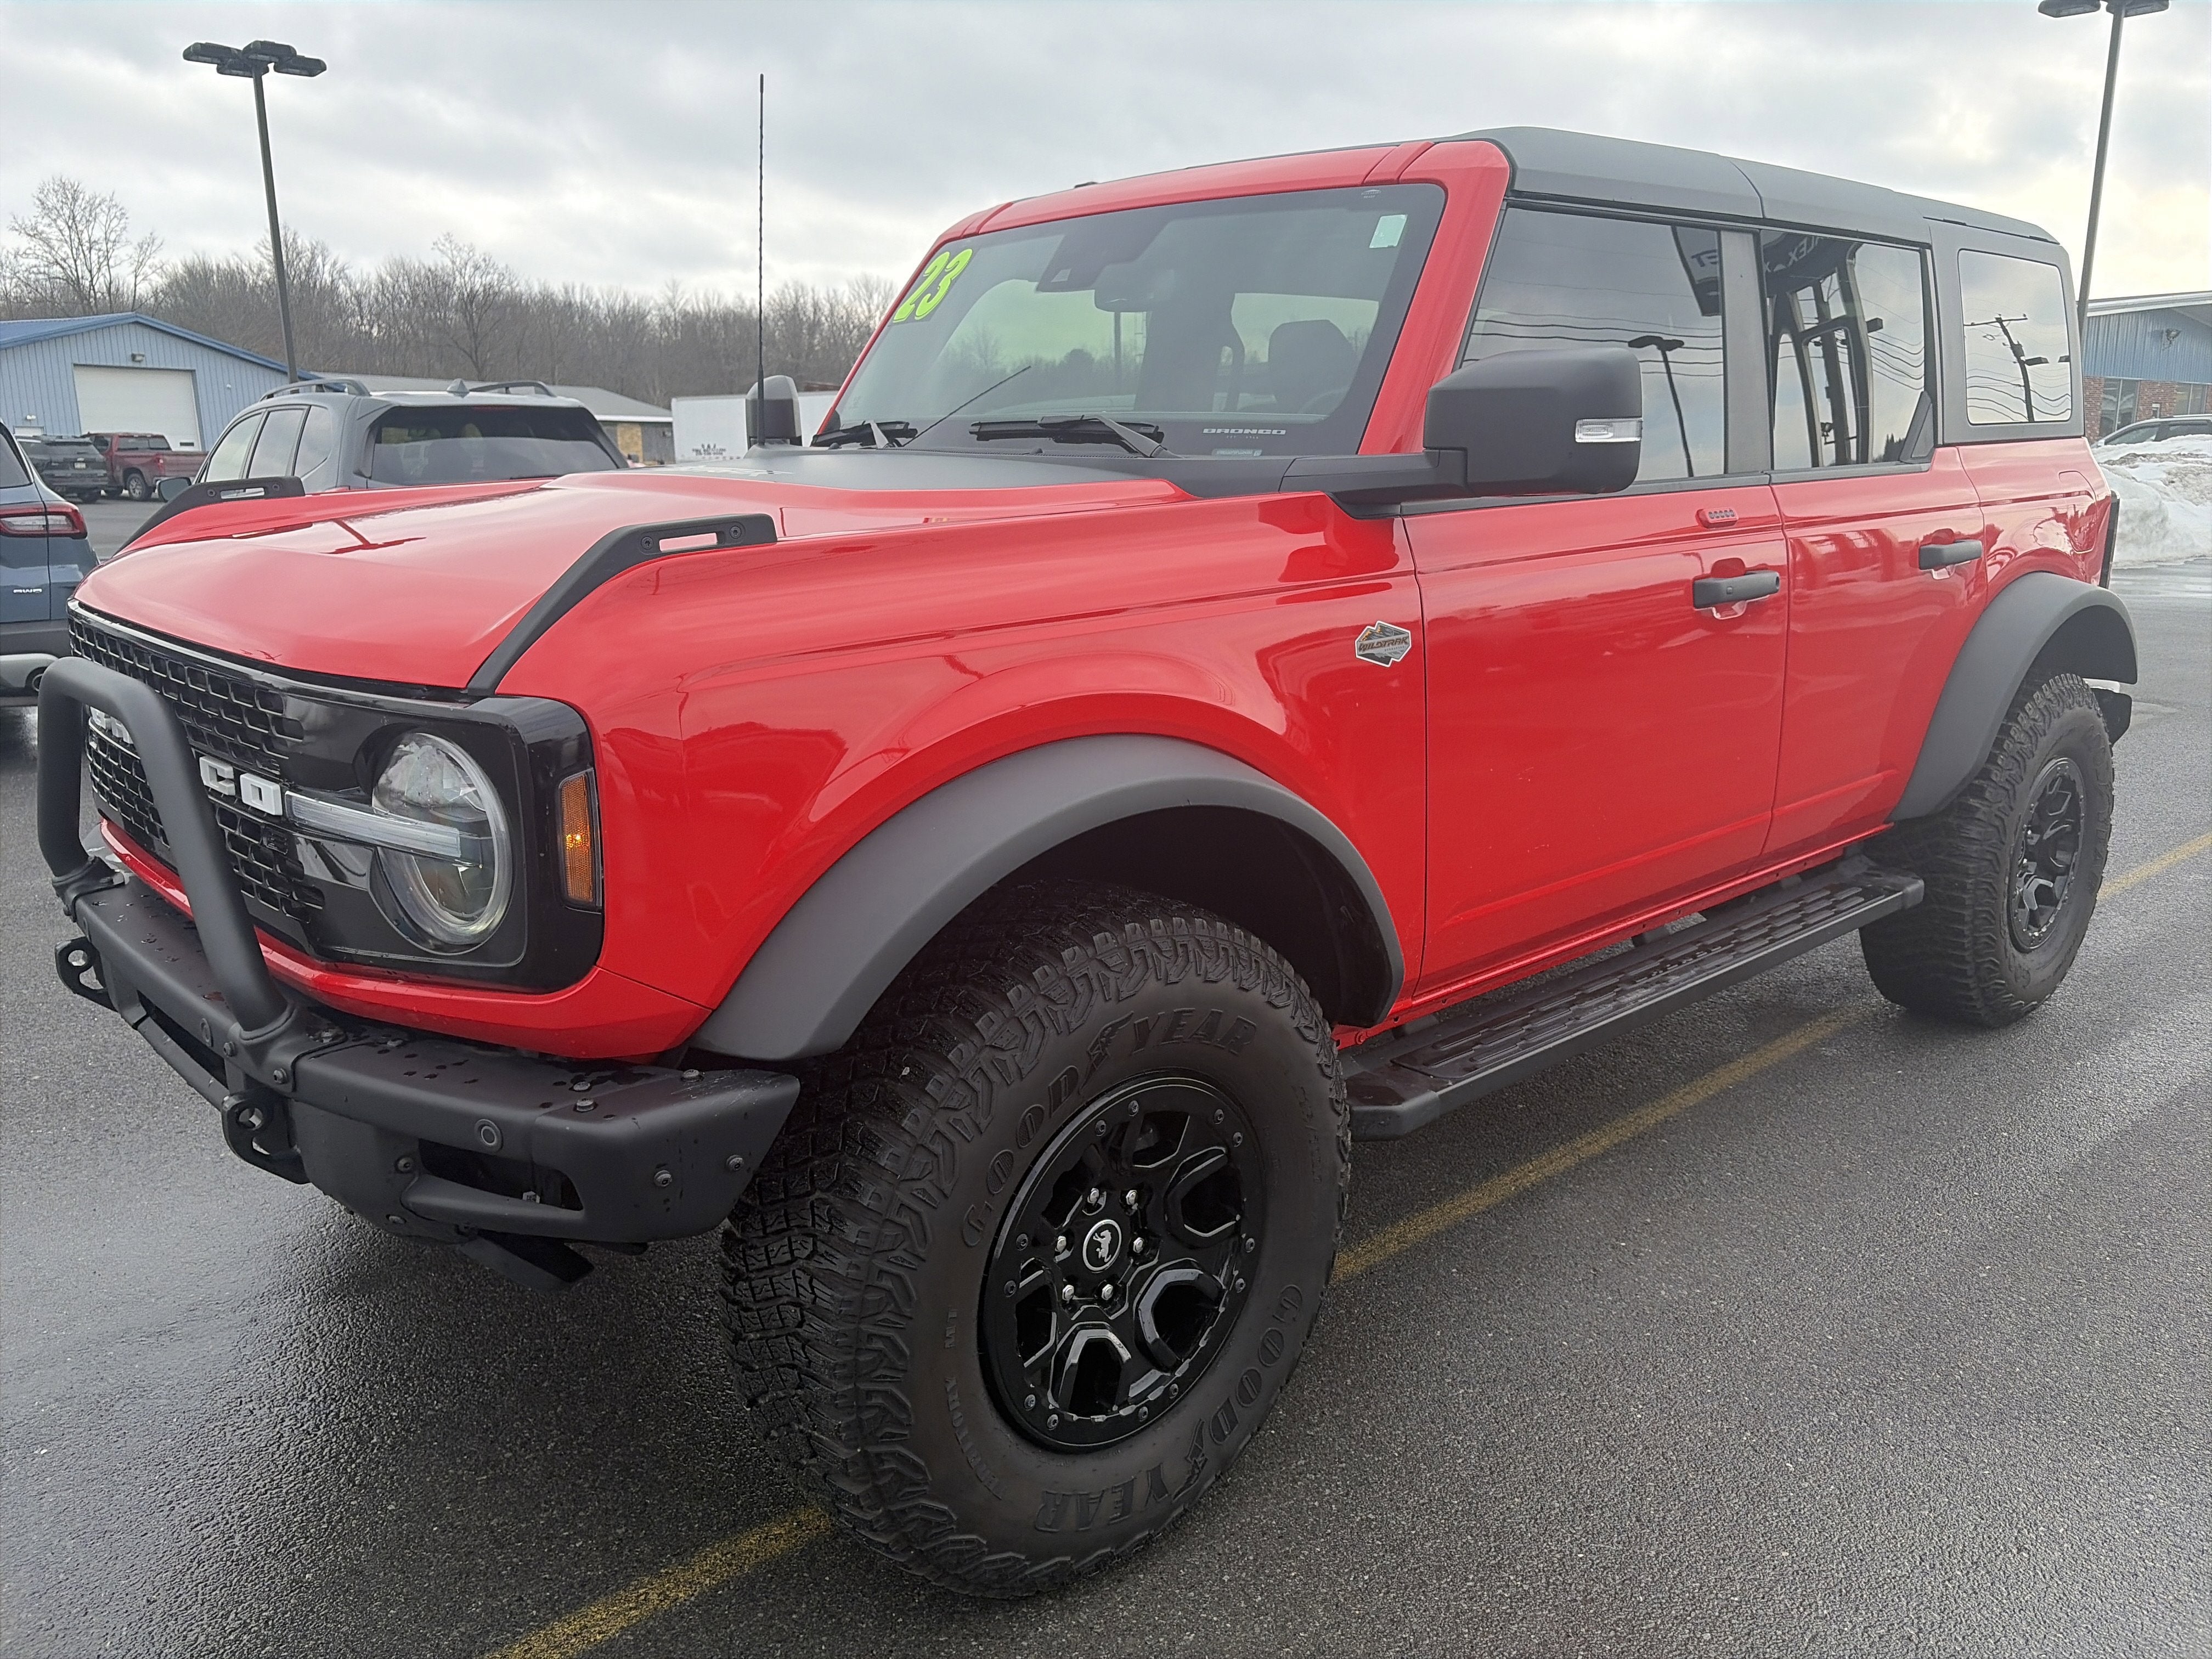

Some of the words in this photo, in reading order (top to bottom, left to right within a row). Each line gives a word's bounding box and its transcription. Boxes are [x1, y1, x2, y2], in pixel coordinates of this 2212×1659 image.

[893, 249, 973, 323] 23
[1359, 636, 1409, 652] WILDTRAK
[91, 706, 283, 816] BRCO
[944, 1306, 958, 1349] MT
